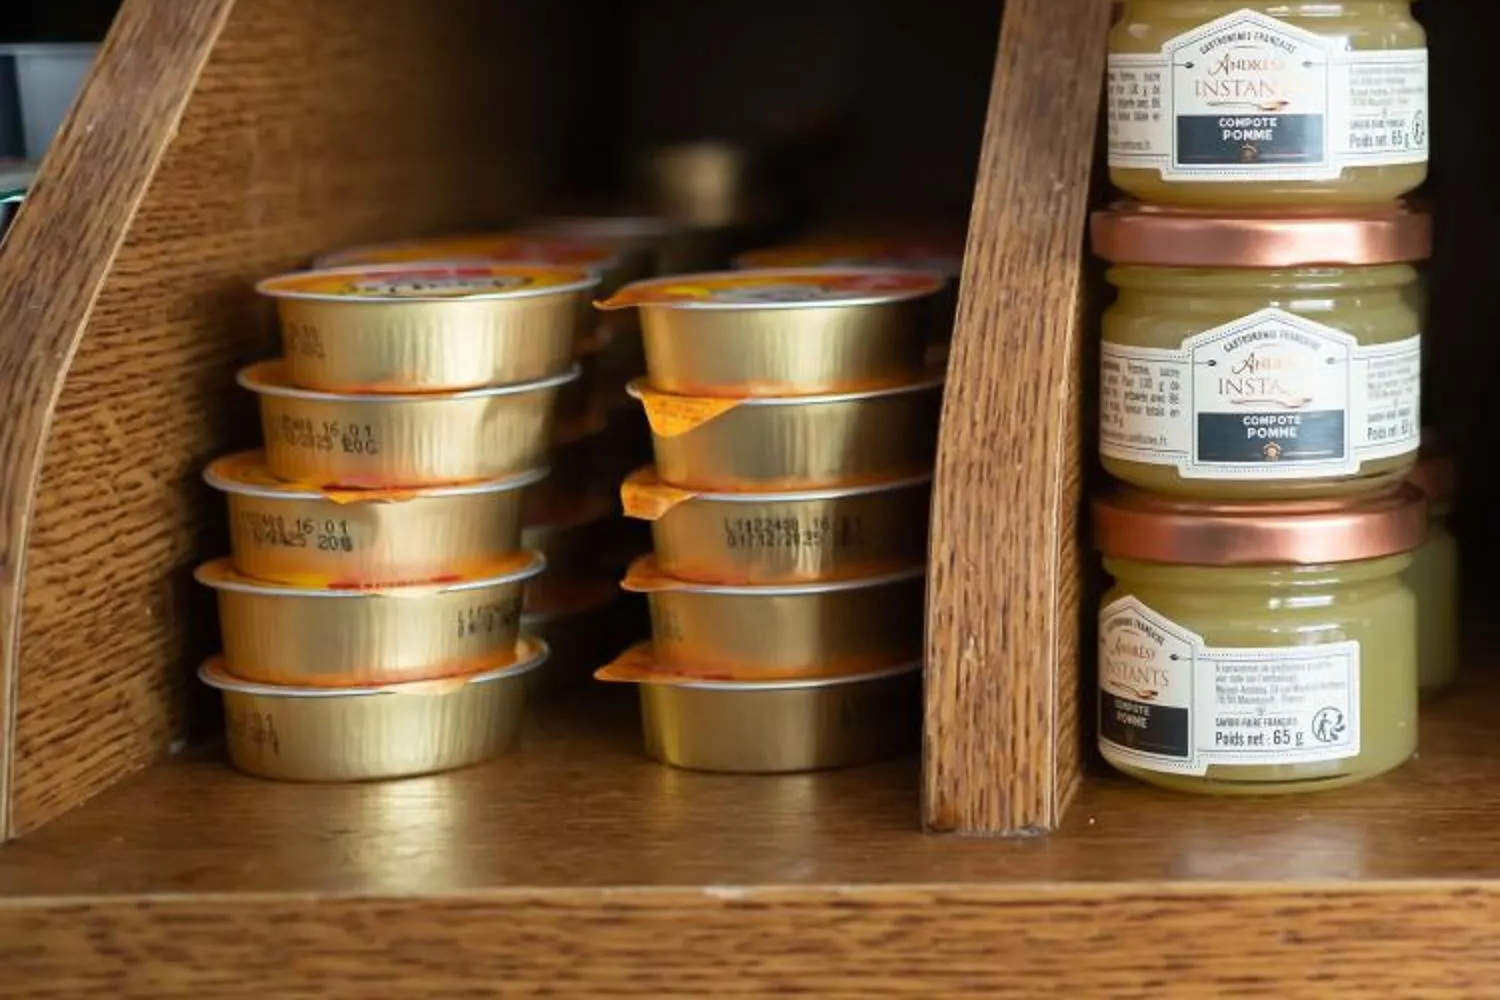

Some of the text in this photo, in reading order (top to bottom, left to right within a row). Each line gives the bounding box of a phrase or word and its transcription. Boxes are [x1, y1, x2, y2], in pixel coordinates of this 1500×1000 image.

[1194, 79, 1292, 98] INSTAN
[1219, 117, 1278, 128] COMPOTE
[1222, 129, 1273, 141] POMME
[1219, 378, 1294, 395] INSTA
[1243, 415, 1303, 426] COMPOTE
[1247, 427, 1297, 439] POMME
[1105, 655, 1170, 689] STANTS
[1215, 730, 1244, 746] Poids
[1246, 732, 1264, 746] net
[1272, 729, 1291, 746] 65
[1295, 730, 1305, 747] g
